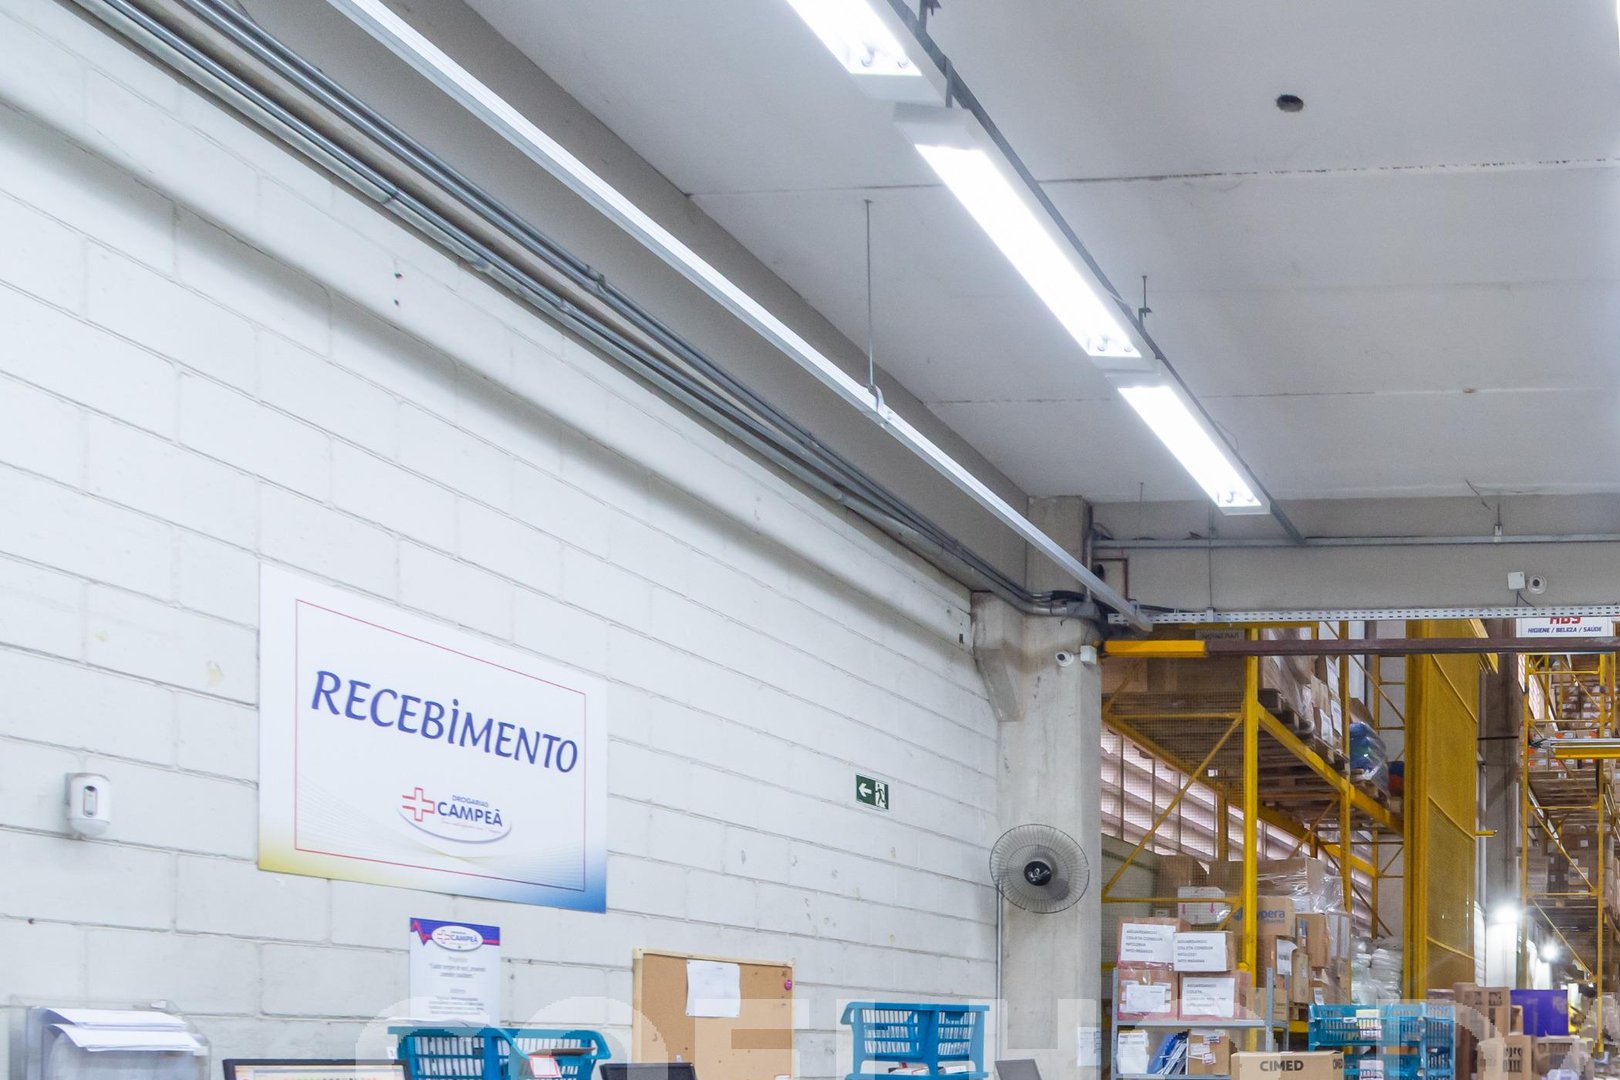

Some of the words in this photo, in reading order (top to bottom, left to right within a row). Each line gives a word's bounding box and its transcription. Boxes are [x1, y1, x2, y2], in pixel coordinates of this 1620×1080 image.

[311, 670, 579, 773] RECEBIMENTO
[437, 801, 503, 827] CAMPEÃ
[1260, 1060, 1304, 1072] CIMED
